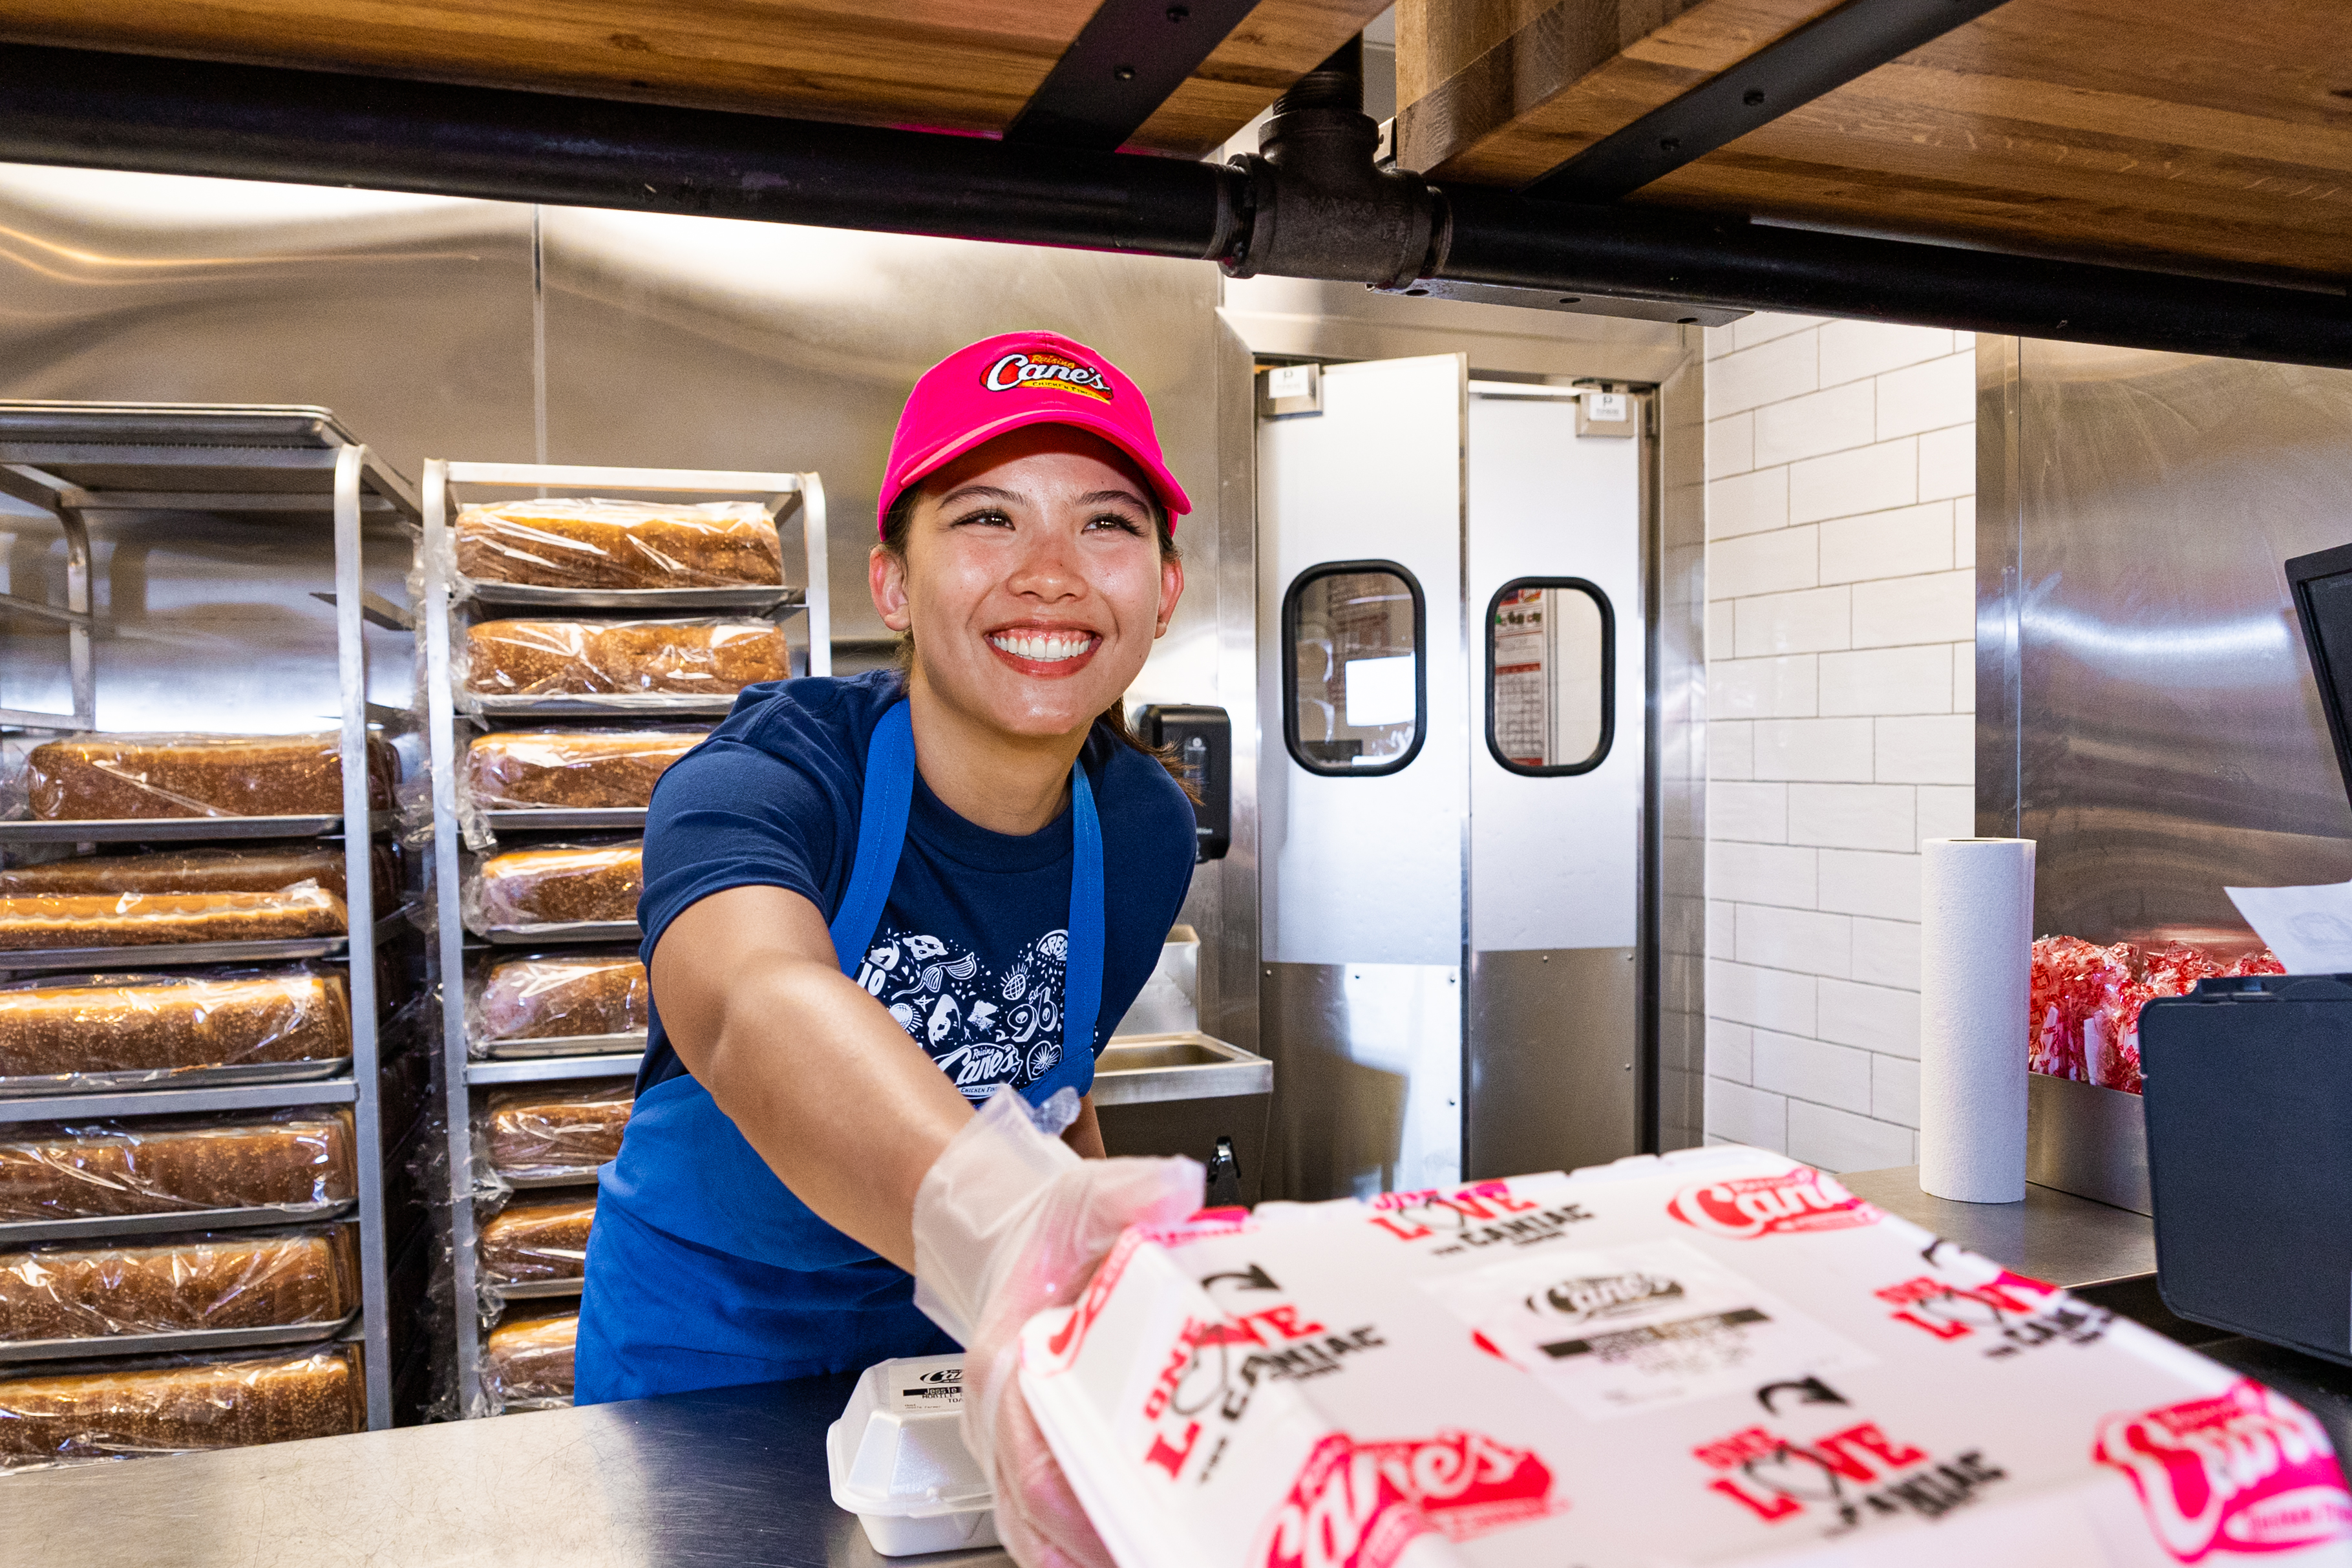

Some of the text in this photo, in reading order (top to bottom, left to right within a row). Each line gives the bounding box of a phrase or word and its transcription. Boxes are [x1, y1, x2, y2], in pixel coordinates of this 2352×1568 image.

[1032, 355, 1075, 369] Raising
[987, 354, 1111, 391] Cane's
[973, 1047, 995, 1059] Raising
